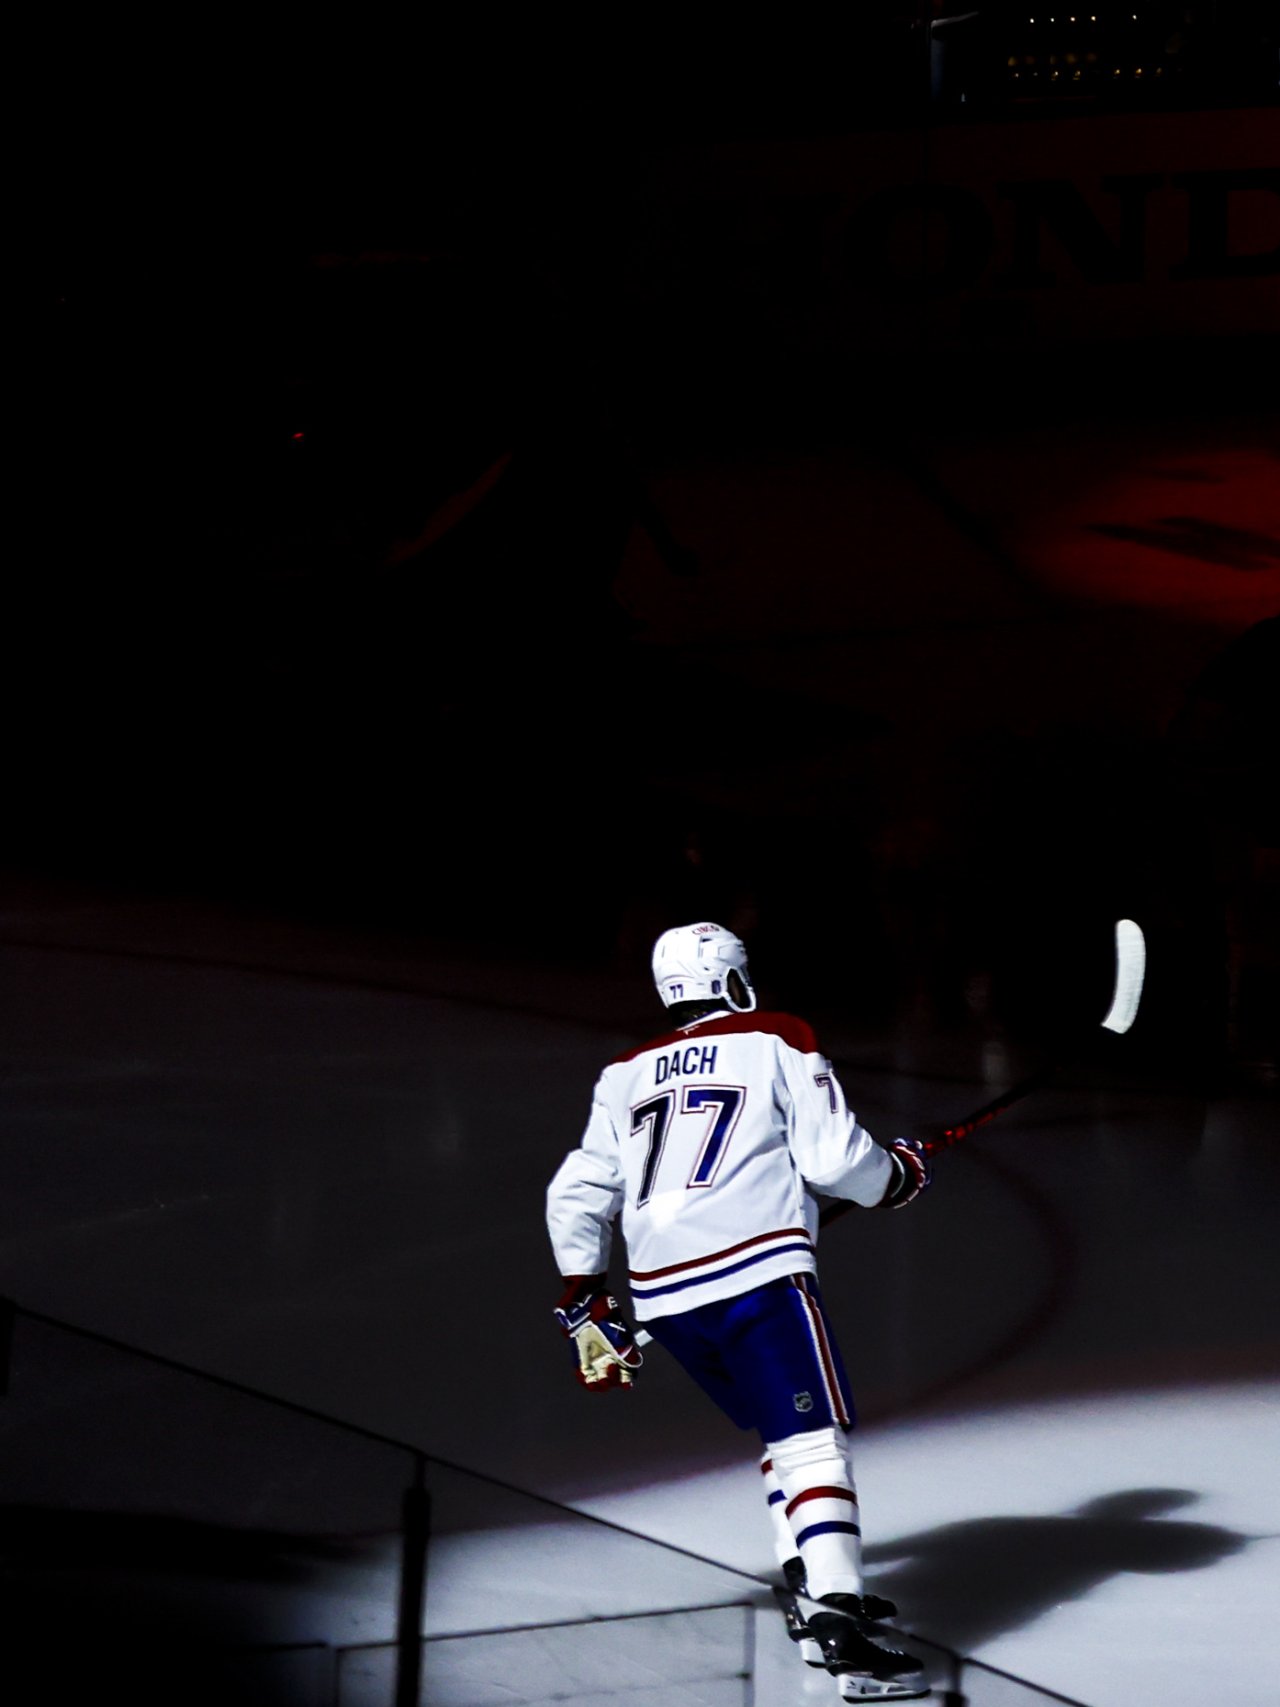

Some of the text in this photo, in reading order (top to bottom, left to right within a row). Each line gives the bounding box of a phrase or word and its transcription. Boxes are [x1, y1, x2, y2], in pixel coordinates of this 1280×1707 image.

[669, 983, 684, 999] 77
[655, 1045, 718, 1086] DACH
[629, 1084, 747, 1211] 77
